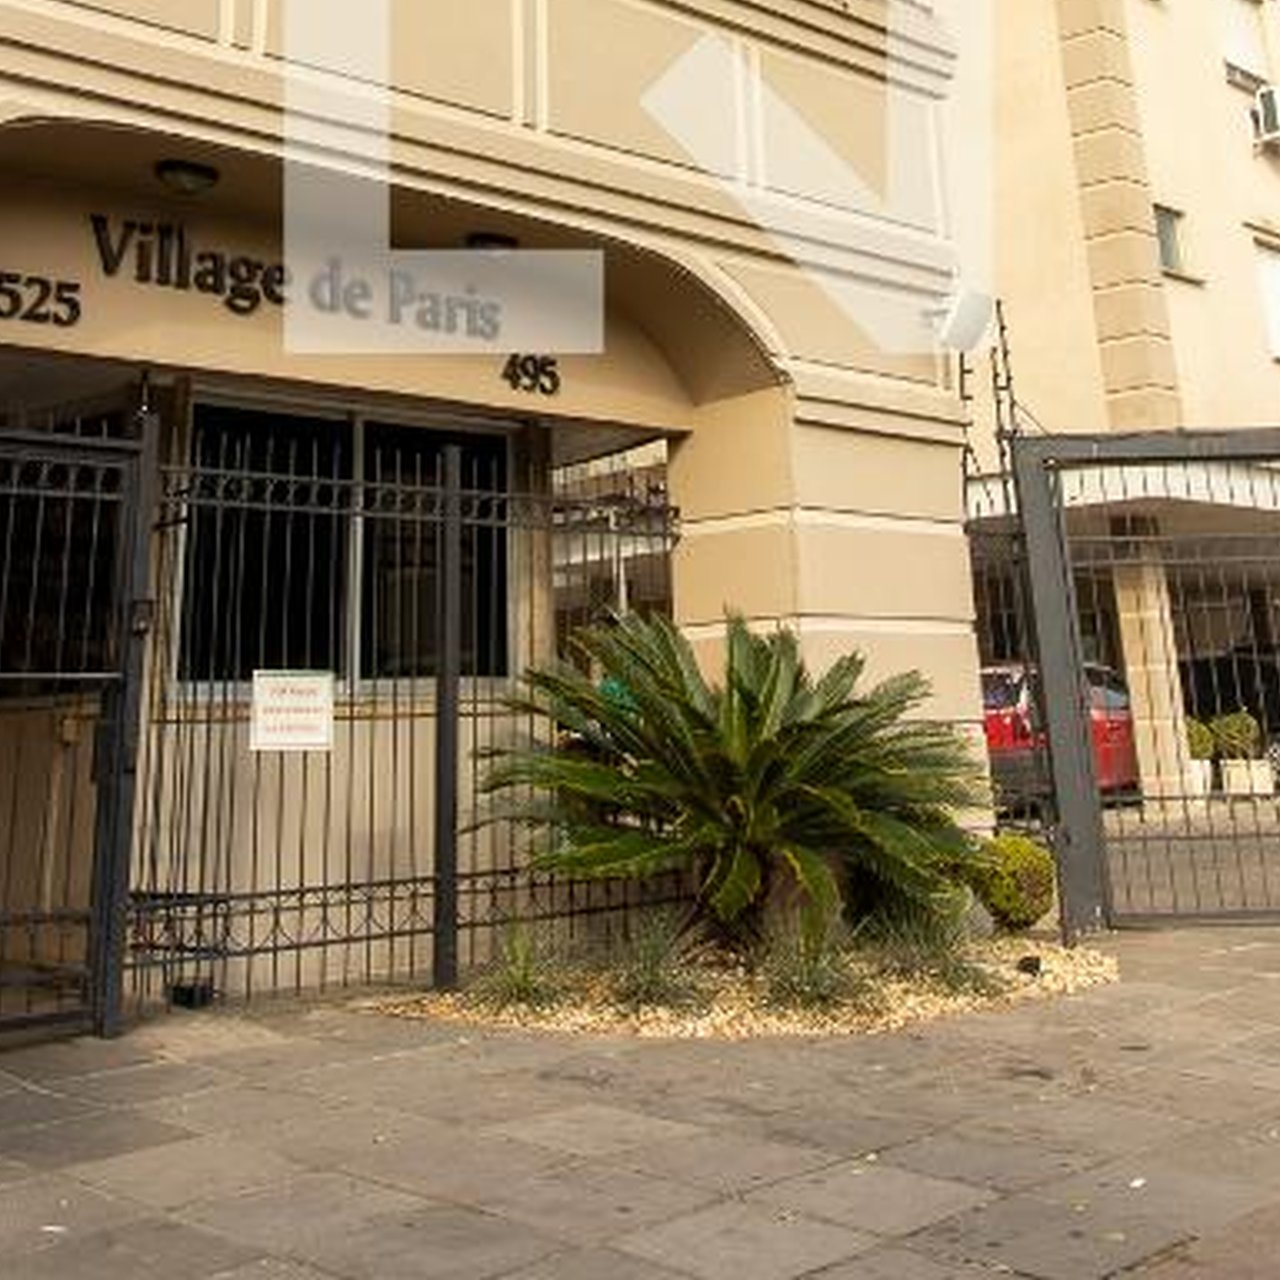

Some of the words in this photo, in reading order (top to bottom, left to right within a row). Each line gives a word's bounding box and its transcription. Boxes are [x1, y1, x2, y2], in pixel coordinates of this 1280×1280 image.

[90, 213, 292, 315] Village
[308, 256, 372, 318] de
[387, 268, 502, 340] Paris
[501, 353, 560, 396] 495
